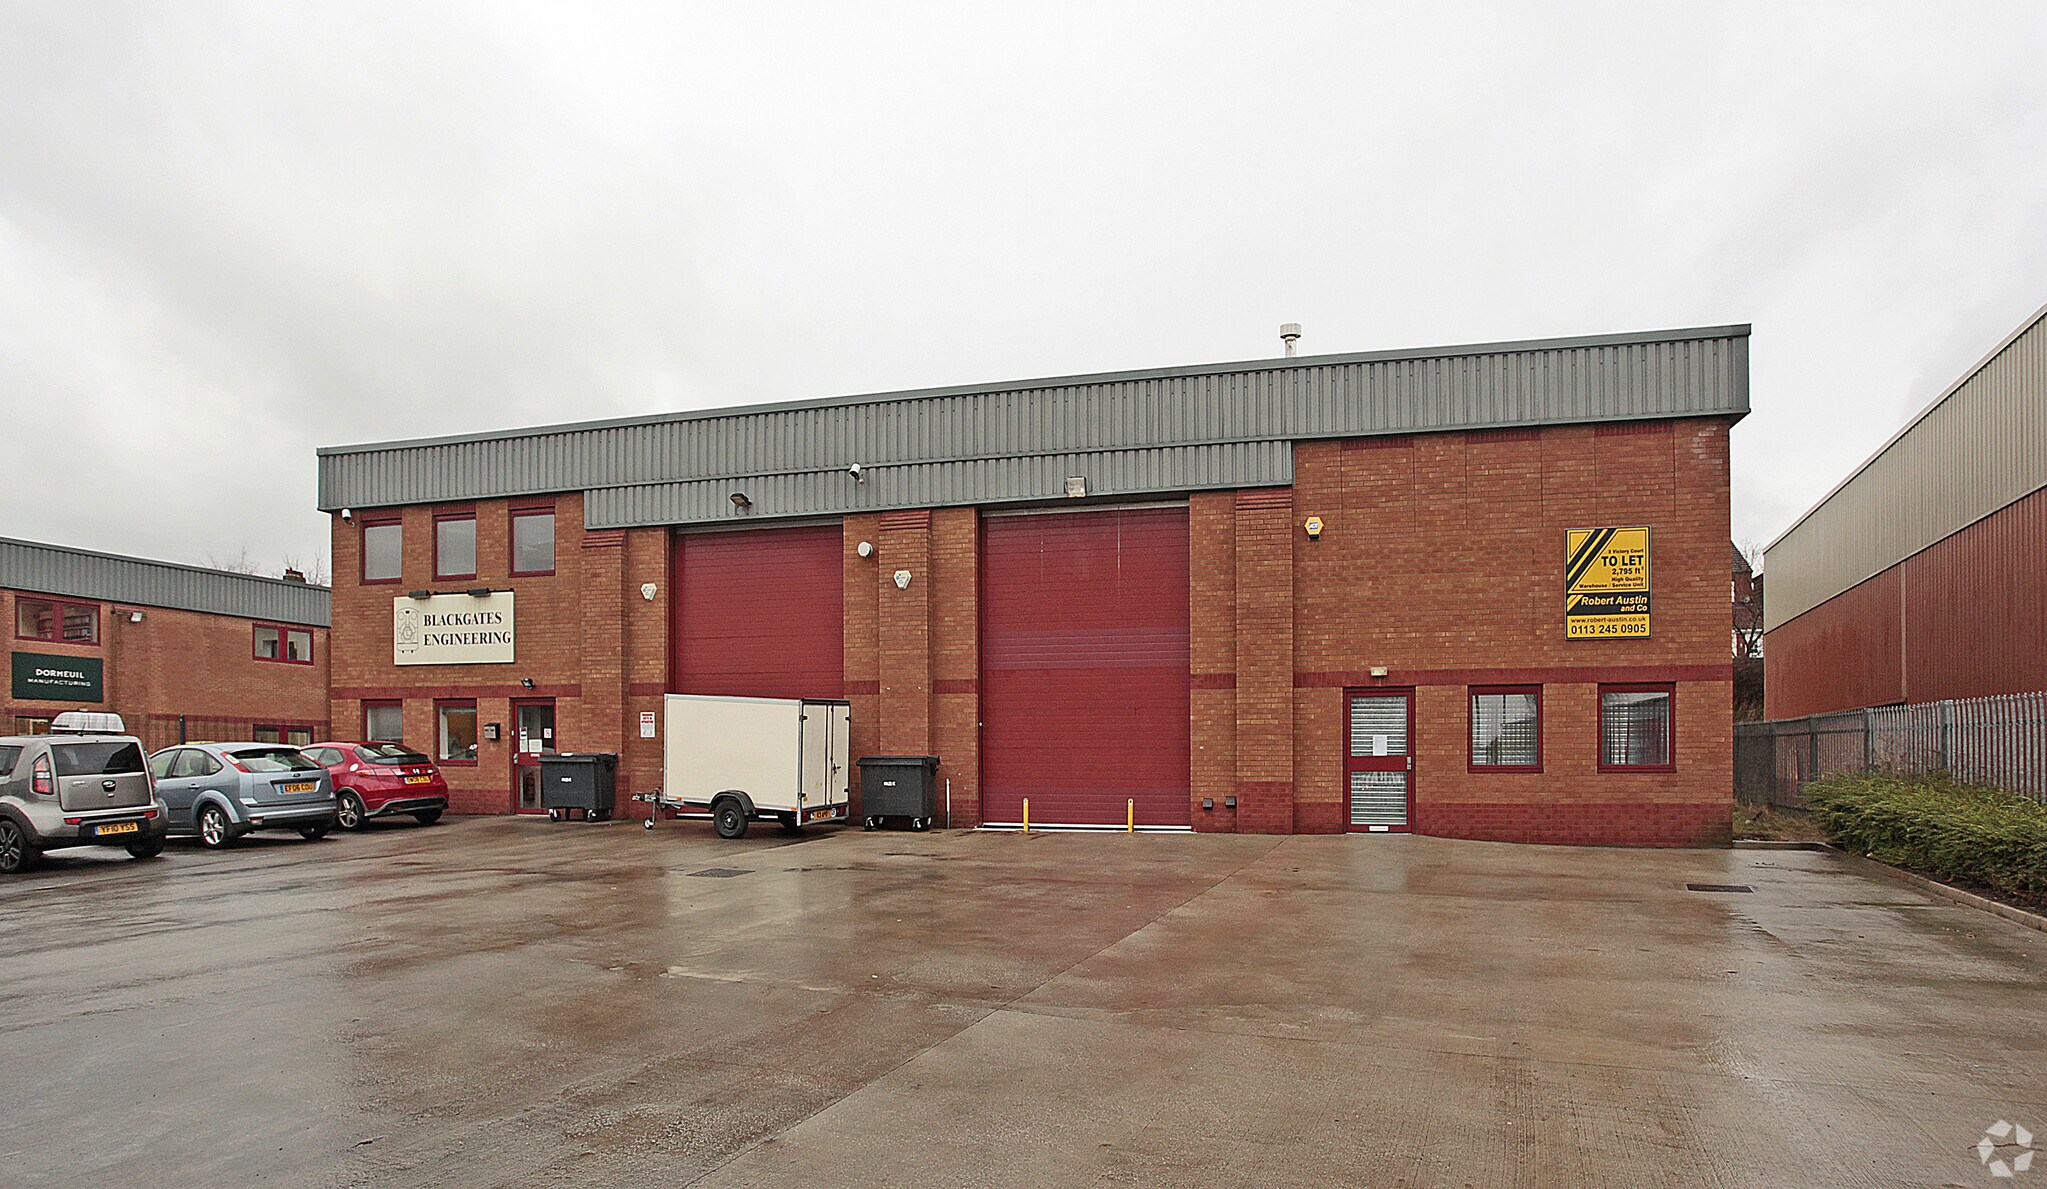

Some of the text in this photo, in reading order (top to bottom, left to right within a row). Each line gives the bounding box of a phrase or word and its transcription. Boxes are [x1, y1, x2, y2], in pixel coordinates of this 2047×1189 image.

[1601, 554, 1644, 566] TO LET
[1612, 567, 1633, 575] 2,795
[1581, 595, 1648, 605] Robert Austin
[1636, 604, 1648, 612] Co
[424, 612, 502, 627] BLACKGATES
[1571, 623, 1646, 634] 0113 245 0905
[424, 631, 511, 646] ENGINEERING
[36, 668, 84, 678] DORMEUIL
[27, 678, 91, 686] MANUFACTURING
[101, 825, 119, 833] YF10
